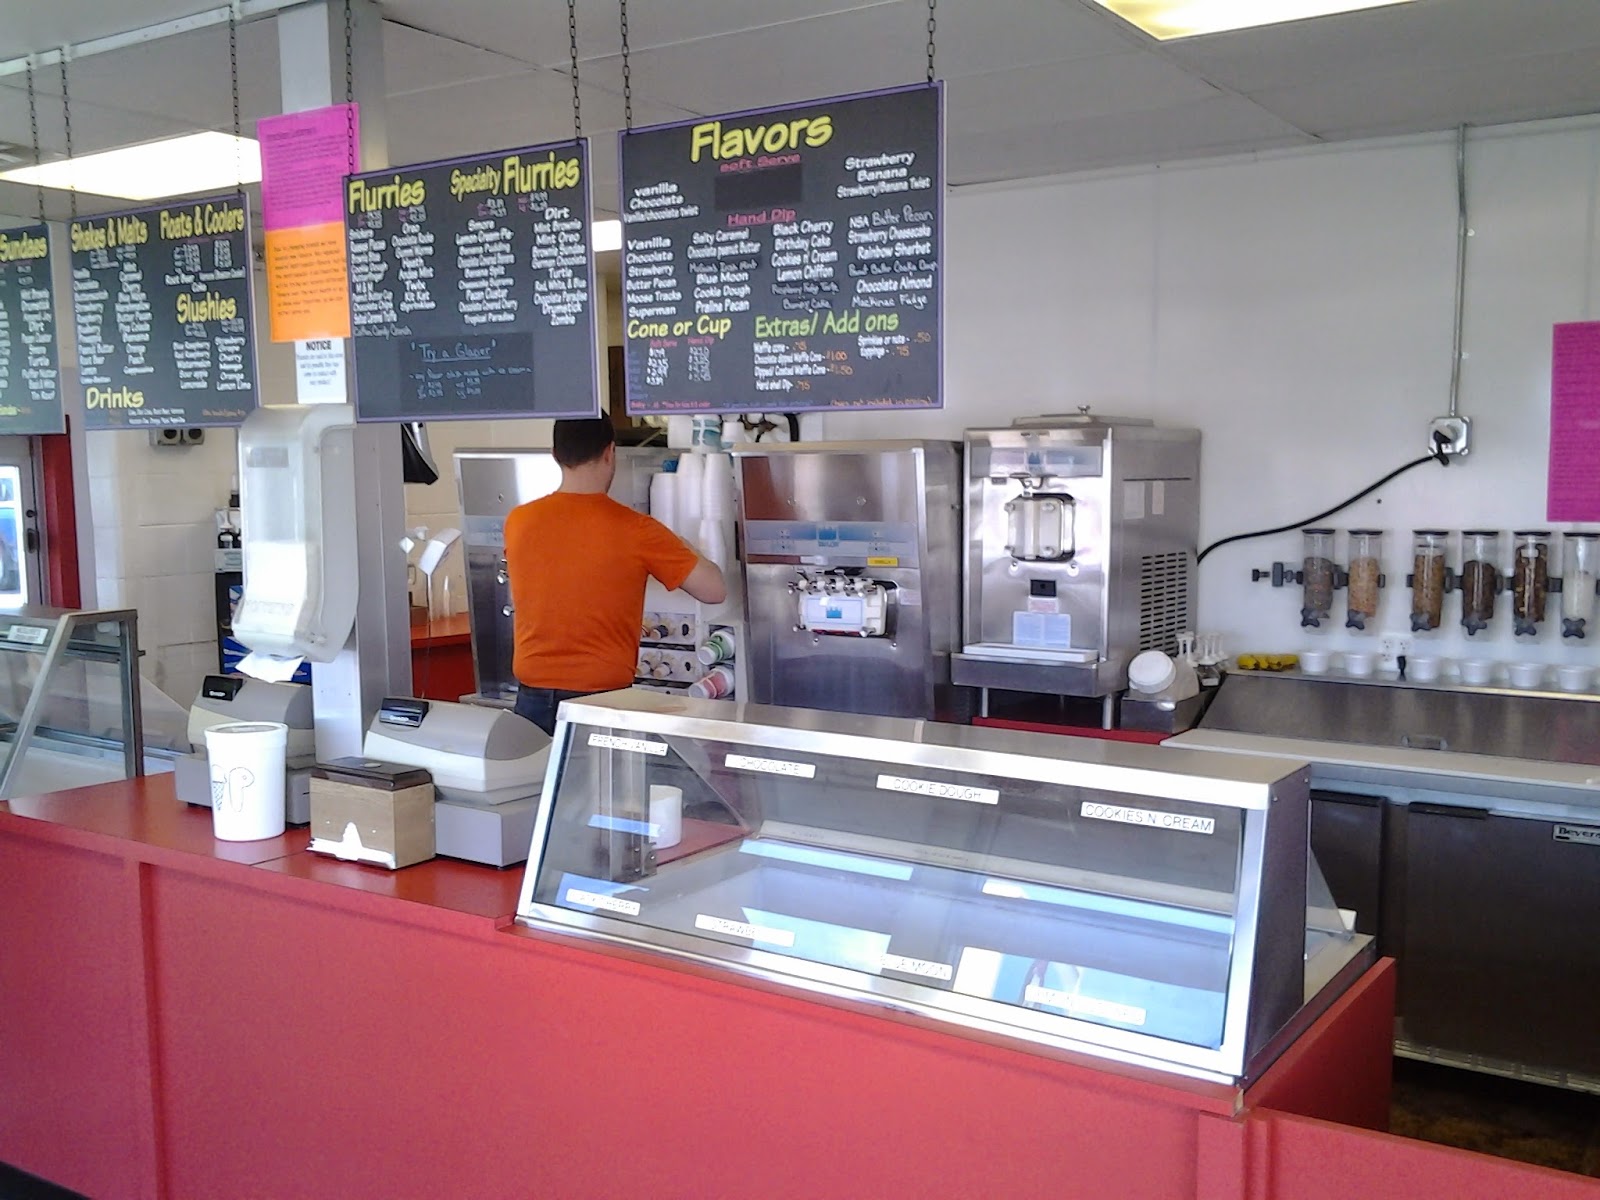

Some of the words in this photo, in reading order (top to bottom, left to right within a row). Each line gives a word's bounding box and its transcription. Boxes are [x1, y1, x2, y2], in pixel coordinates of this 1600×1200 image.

[689, 114, 834, 163] Flavors
[845, 152, 916, 171] Strawberry
[449, 164, 502, 203] Specialty
[502, 150, 581, 196] Flurries
[857, 167, 908, 183] Banana
[348, 174, 426, 215] Flurries
[629, 194, 685, 211] Chocolate
[193, 206, 205, 237] &
[204, 202, 246, 233] Coolers
[544, 206, 571, 221] Dirt
[727, 211, 767, 227] Hand
[770, 208, 797, 224] Dip
[800, 219, 835, 235] Cherry
[557, 231, 581, 244] Oreo
[626, 250, 674, 265] Chocolate
[719, 271, 749, 284] Moon
[899, 273, 933, 291] Almond
[722, 283, 752, 299] Dough
[175, 291, 238, 325] Slushies
[627, 304, 677, 319] Superman
[899, 293, 929, 311] Fudge
[626, 317, 669, 340] Cone
[671, 318, 694, 336] or
[695, 314, 733, 342] Cup
[754, 310, 818, 338] Extras/
[822, 308, 860, 335] Add
[863, 312, 900, 332] ons
[305, 340, 332, 351] NOTICE
[85, 386, 145, 411] Drinks
[740, 756, 801, 775] CHOCOLATE
[893, 778, 938, 795] COOKIE
[938, 784, 983, 800] DOUGH
[1085, 803, 1146, 824] COOKIES
[1147, 812, 1158, 825] N
[1162, 814, 1214, 834] CREAM
